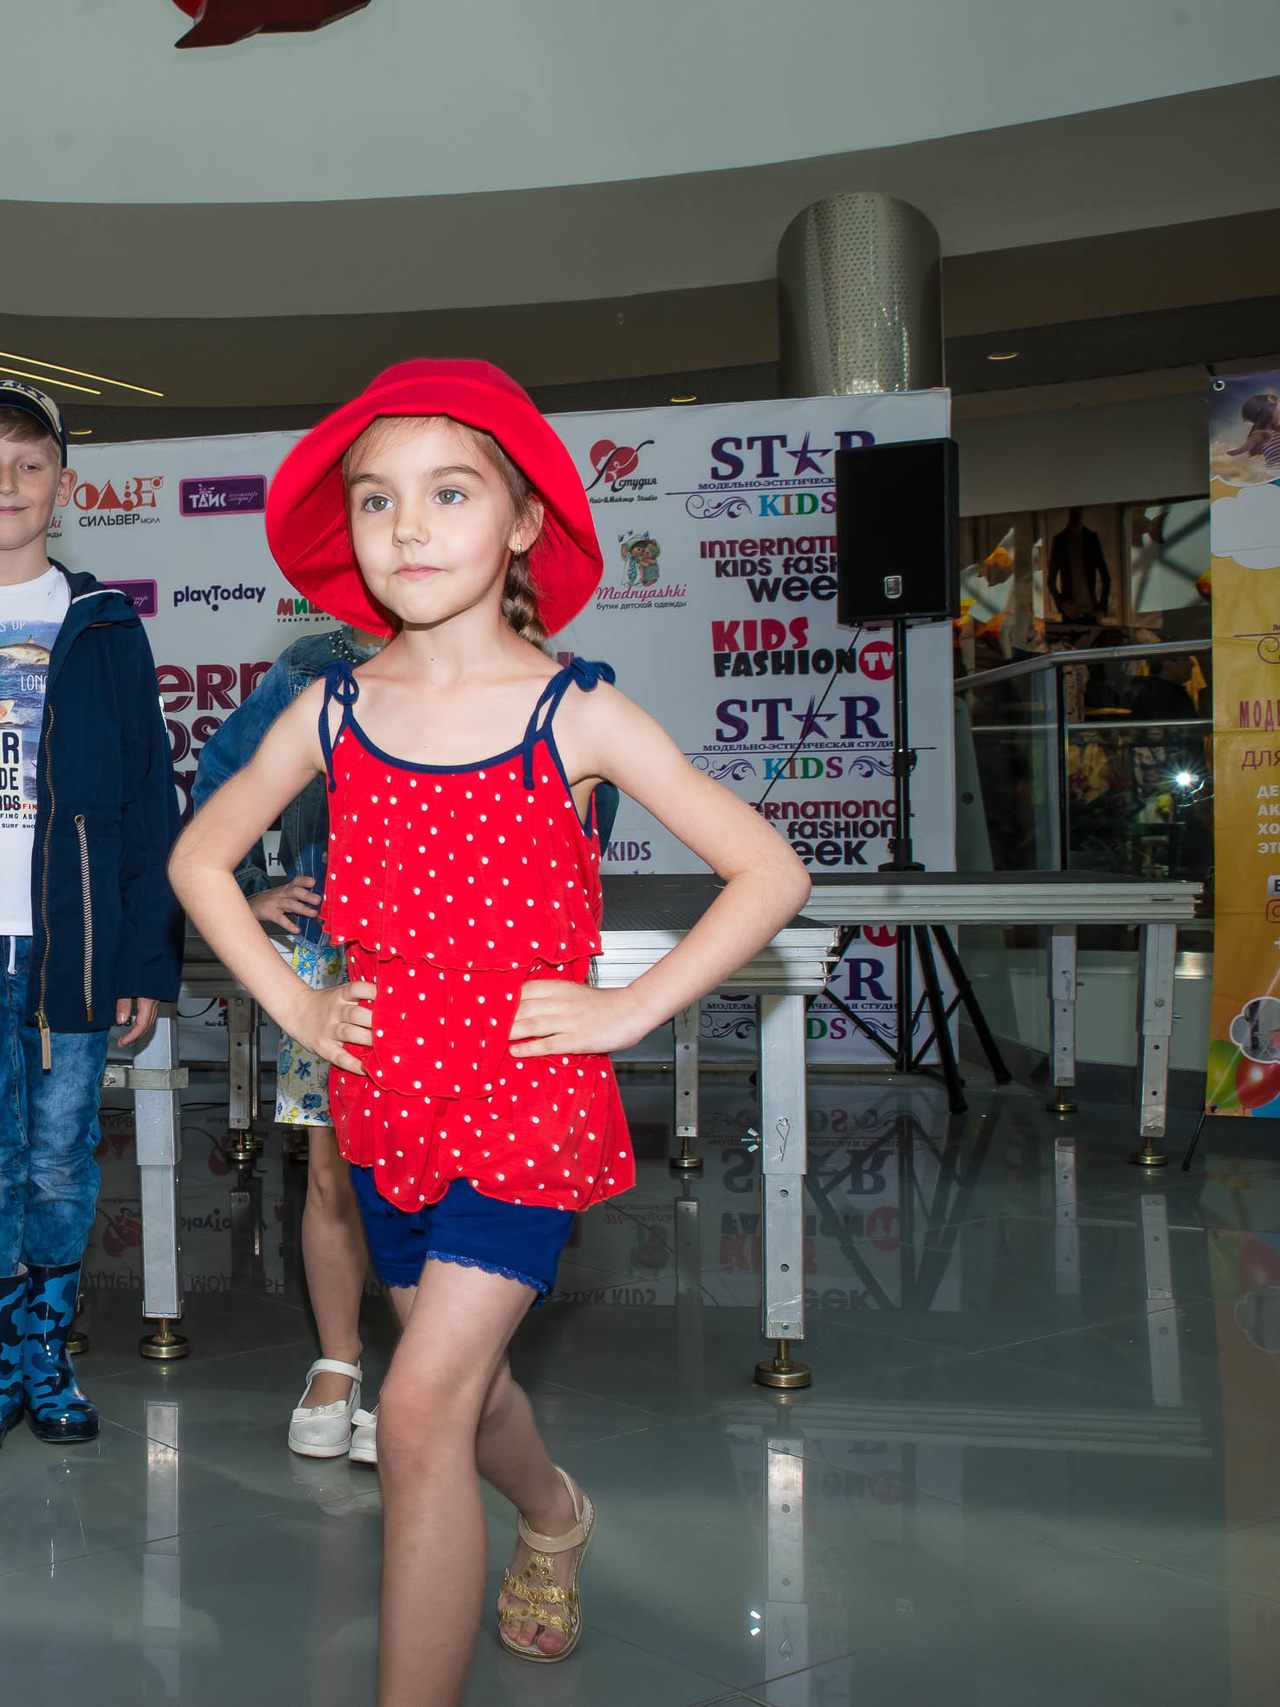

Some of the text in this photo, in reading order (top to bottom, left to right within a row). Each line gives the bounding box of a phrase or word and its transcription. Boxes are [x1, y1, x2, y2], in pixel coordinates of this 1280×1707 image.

[698, 476, 837, 490] МОДЕЛЬНО-ЭСТЕТИЧЕСК
[757, 491, 837, 517] KIDS
[78, 513, 141, 527] СИЛЬВЕР
[715, 558, 773, 578] KIDS
[173, 583, 266, 608] playToday
[595, 583, 687, 602] Modnyashki
[746, 575, 837, 603] wee
[596, 601, 687, 611] бутик детской одежды
[711, 616, 809, 653] KIDS
[713, 647, 857, 678] FASHION
[1239, 699, 1280, 732] МОД
[856, 739, 895, 749] СТУДИ
[762, 756, 844, 780] KIDS
[607, 840, 652, 862] KIDS
[789, 840, 869, 867] eek
[860, 1002, 898, 1010] СТУДИ
